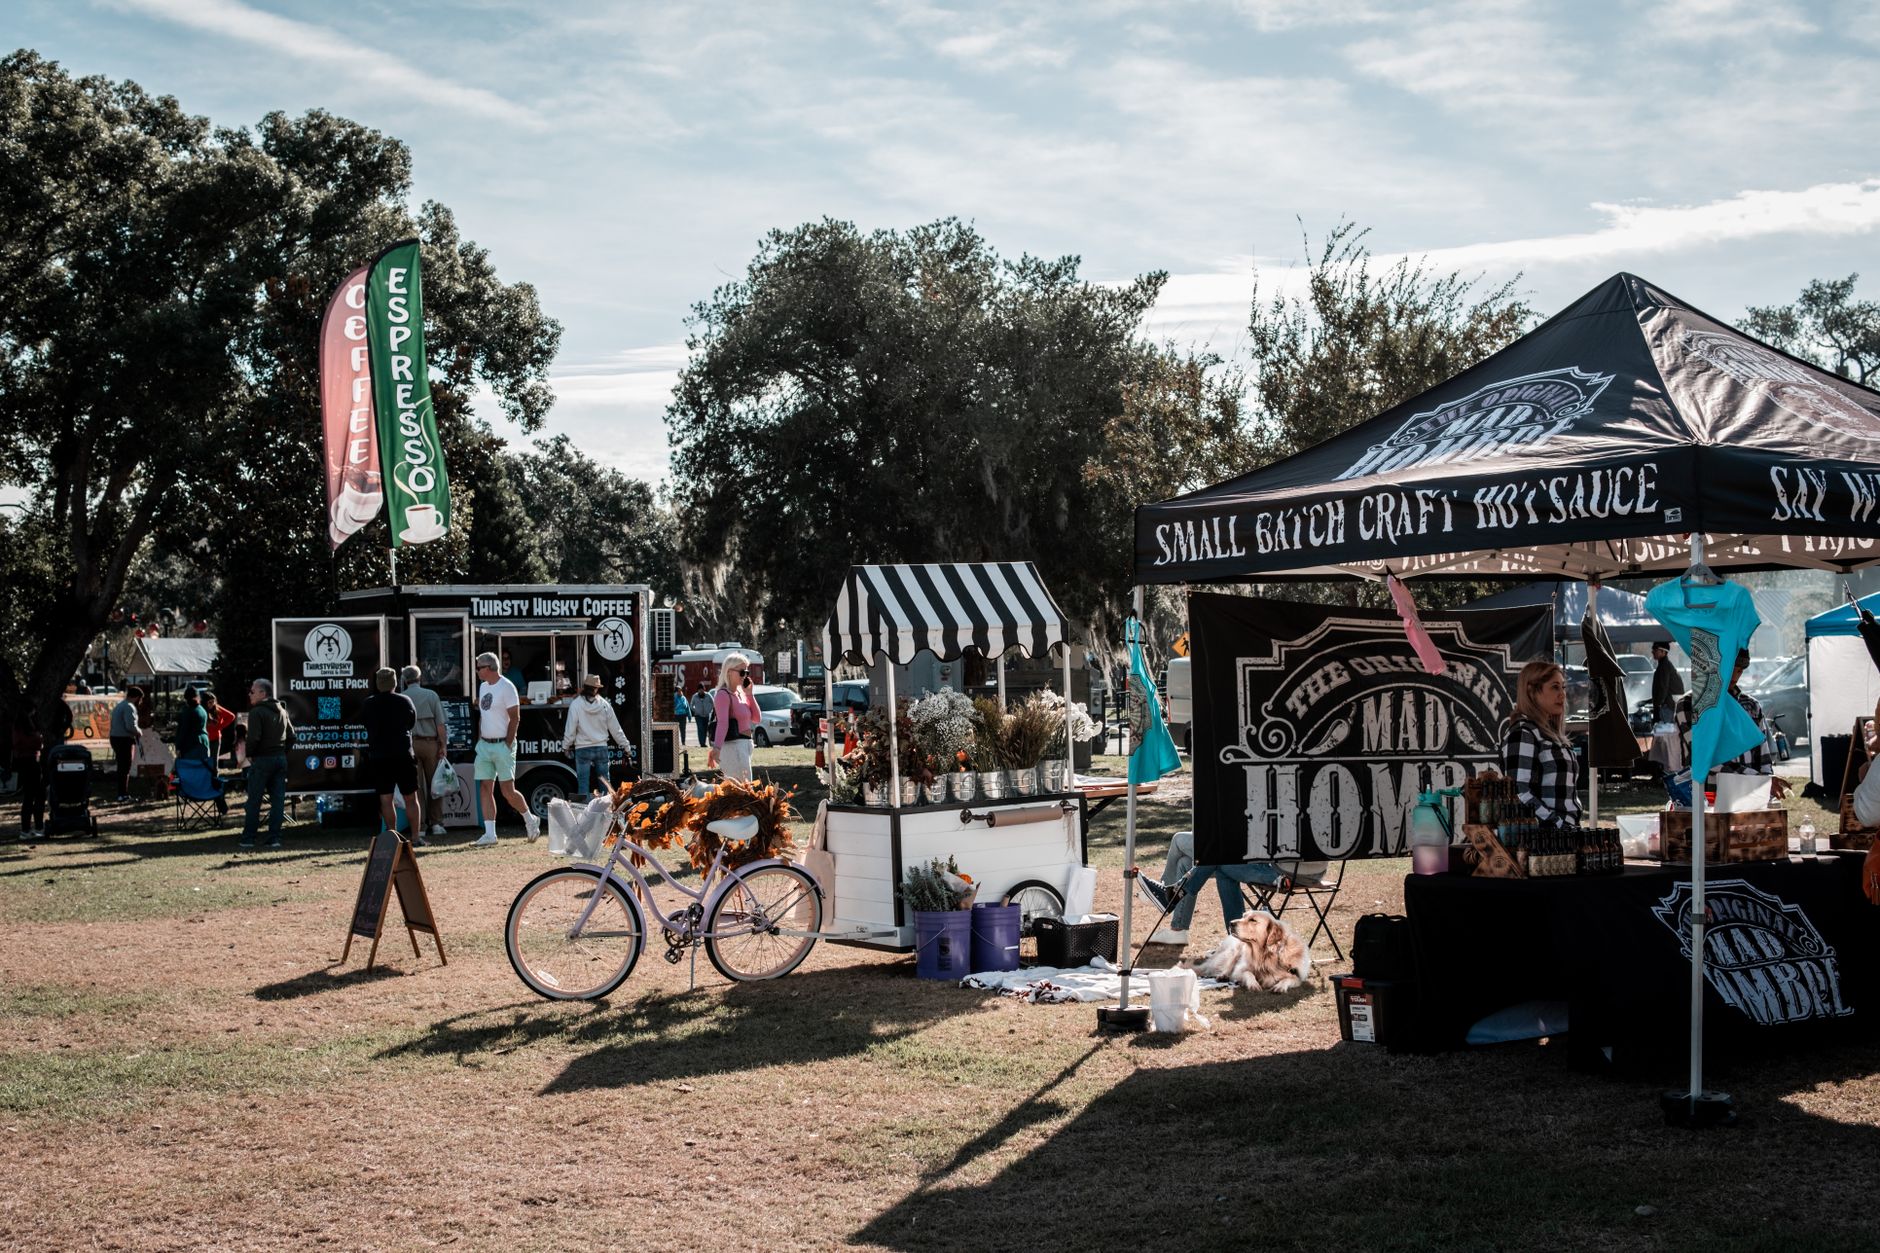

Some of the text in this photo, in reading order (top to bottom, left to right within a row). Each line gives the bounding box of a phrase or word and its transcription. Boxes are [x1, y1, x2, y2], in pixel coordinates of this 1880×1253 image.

[344, 284, 371, 465] COFFEE
[387, 267, 435, 493] ESPRESSO
[1331, 415, 1577, 482] HOMBRE
[1438, 404, 1533, 438] MAD
[1770, 466, 1827, 522] SAY
[1154, 515, 1246, 567] SMALL
[1255, 499, 1345, 554] BATCH
[1358, 488, 1457, 546] CRAFT
[471, 597, 632, 616] THIRSTY HUSKY COFFEE
[290, 678, 369, 690] FOLLOW THE PACK
[1285, 655, 1502, 722] THE ORIGNAL
[519, 739, 565, 754] THE PAC
[1361, 690, 1449, 754] MAD
[1703, 959, 1855, 1025] OMBRE
